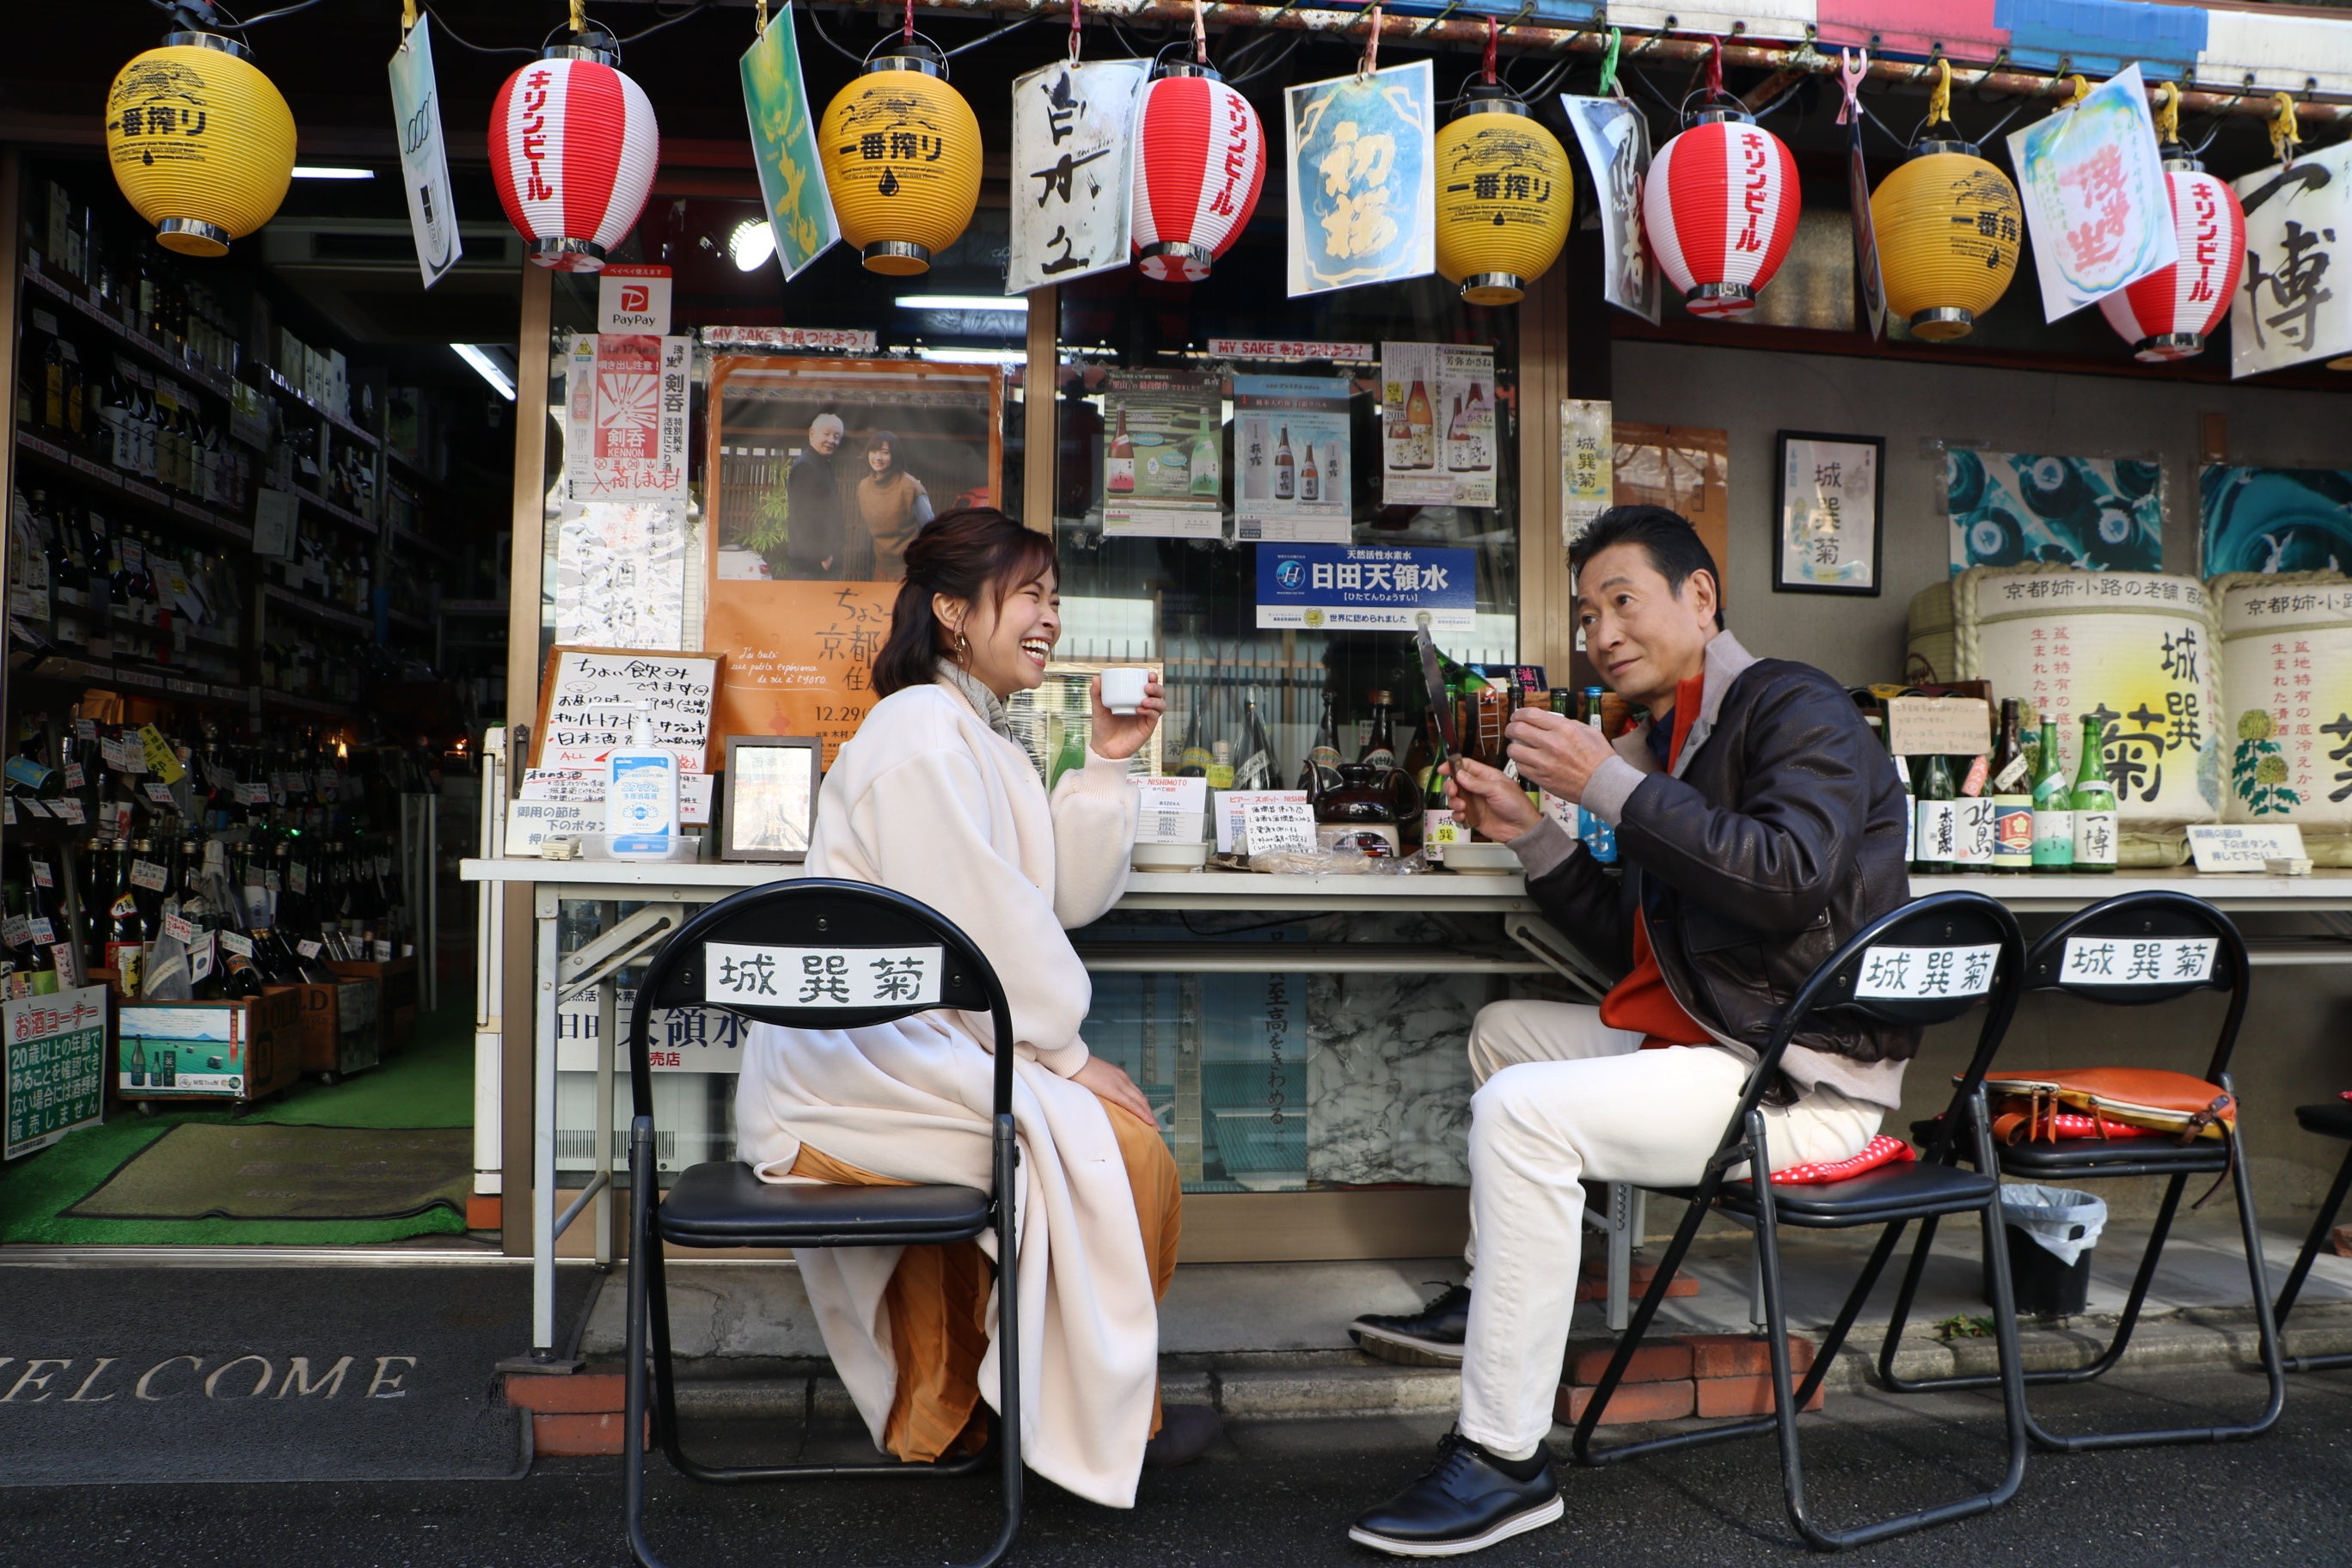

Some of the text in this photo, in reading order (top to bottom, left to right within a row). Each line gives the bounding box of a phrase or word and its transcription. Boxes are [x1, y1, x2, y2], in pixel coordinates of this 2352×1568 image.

[108, 107, 206, 136] 一番搾り
[523, 70, 552, 200] キリンビール
[840, 132, 942, 161] 一番搾り
[1210, 91, 1252, 217] キリンビール
[1448, 174, 1550, 202] 一番搾り
[1736, 132, 1764, 252] キリンビール
[1951, 211, 2021, 245] 一番搾
[2189, 181, 2215, 303] キリンビール
[2240, 162, 2336, 352] 一博
[612, 314, 656, 326] PayPay
[713, 329, 732, 340] MY
[737, 329, 773, 342] SAKE
[1218, 341, 1238, 353] MY
[1242, 342, 1276, 354] SAKE
[1386, 411, 1406, 420] 2018
[608, 448, 644, 457] KENNON
[1577, 437, 1596, 488] 城巽菊
[1814, 462, 1842, 565] 城巽菊
[1347, 549, 1412, 560] 天然活性水素水
[1312, 563, 1449, 591] 日田天領水
[2003, 579, 2179, 600] 京都姉小路の老舗
[1330, 614, 1407, 623] 世界に認められました
[814, 622, 881, 670] 京都
[573, 658, 690, 680] ちょい飲み
[627, 681, 692, 696] できます
[2270, 642, 2290, 737] 生まれた清酒
[558, 732, 616, 746] 日本酒
[830, 730, 848, 739] 木村
[2293, 640, 2313, 803] 盆地特有の底冷えから
[560, 752, 587, 761] ALL
[517, 806, 580, 818] 御用の節は
[2084, 815, 2110, 859] 一博
[2220, 840, 2278, 849] 下のボタンを
[720, 955, 923, 1003] 城巽菊
[1869, 951, 1991, 995] 城巽菊
[2073, 942, 2209, 981] 城巽菊
[15, 1001, 98, 1041] お酒コーナー
[11, 1032, 101, 1070] 20歳以上の年齢で
[11, 1054, 100, 1093] あることを確認でき
[11, 1075, 99, 1117] ない場合には酒類を
[10, 1102, 98, 1142] 販売しません
[0, 1356, 418, 1403] ELCOME
